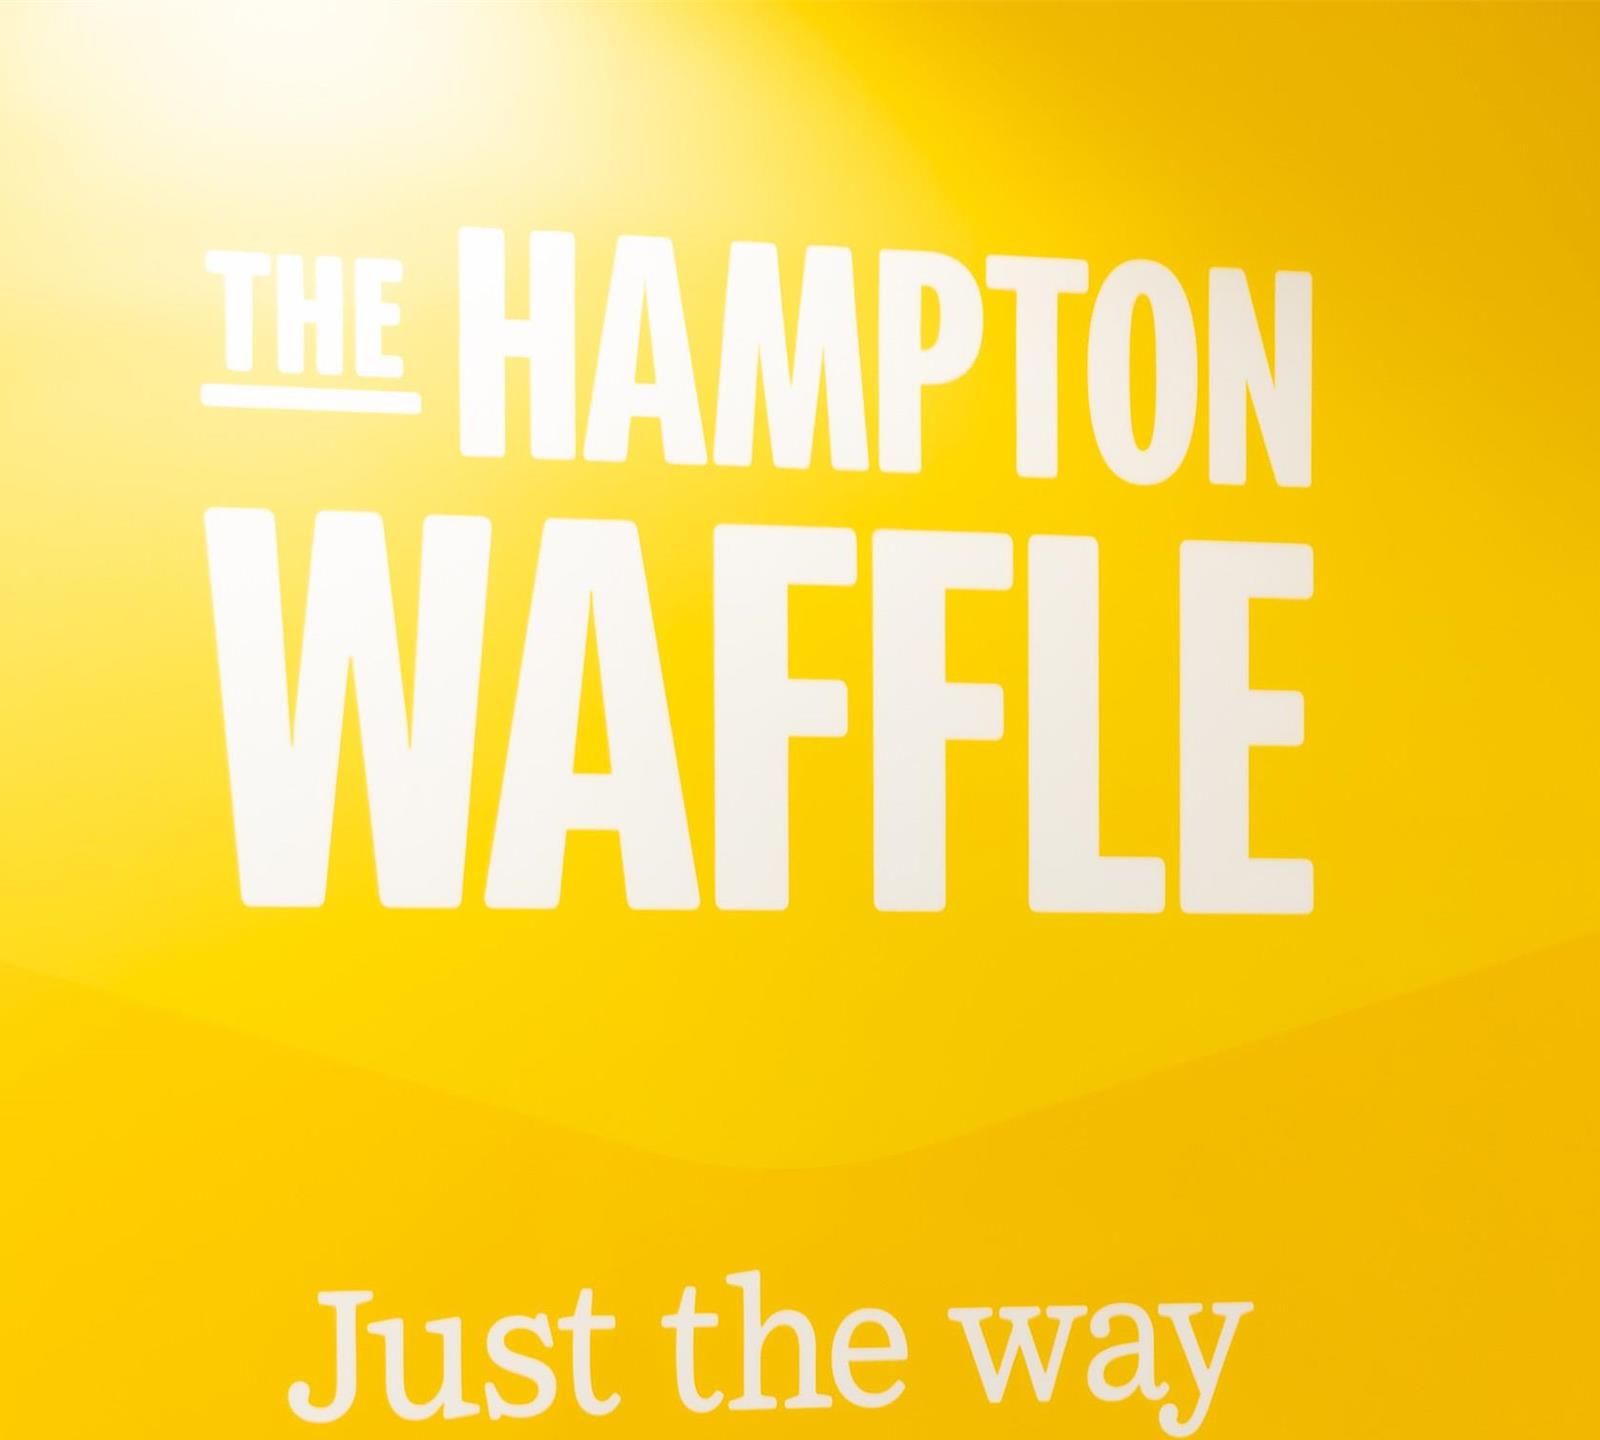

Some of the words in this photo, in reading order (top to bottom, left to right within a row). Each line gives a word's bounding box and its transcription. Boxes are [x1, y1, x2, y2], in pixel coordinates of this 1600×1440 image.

[205, 250, 403, 378] THE
[457, 226, 1312, 488] HAMPTON
[204, 507, 1314, 914] WAFFLE
[287, 1287, 621, 1424] Just
[660, 1269, 909, 1412] the
[947, 1300, 1254, 1438] way
